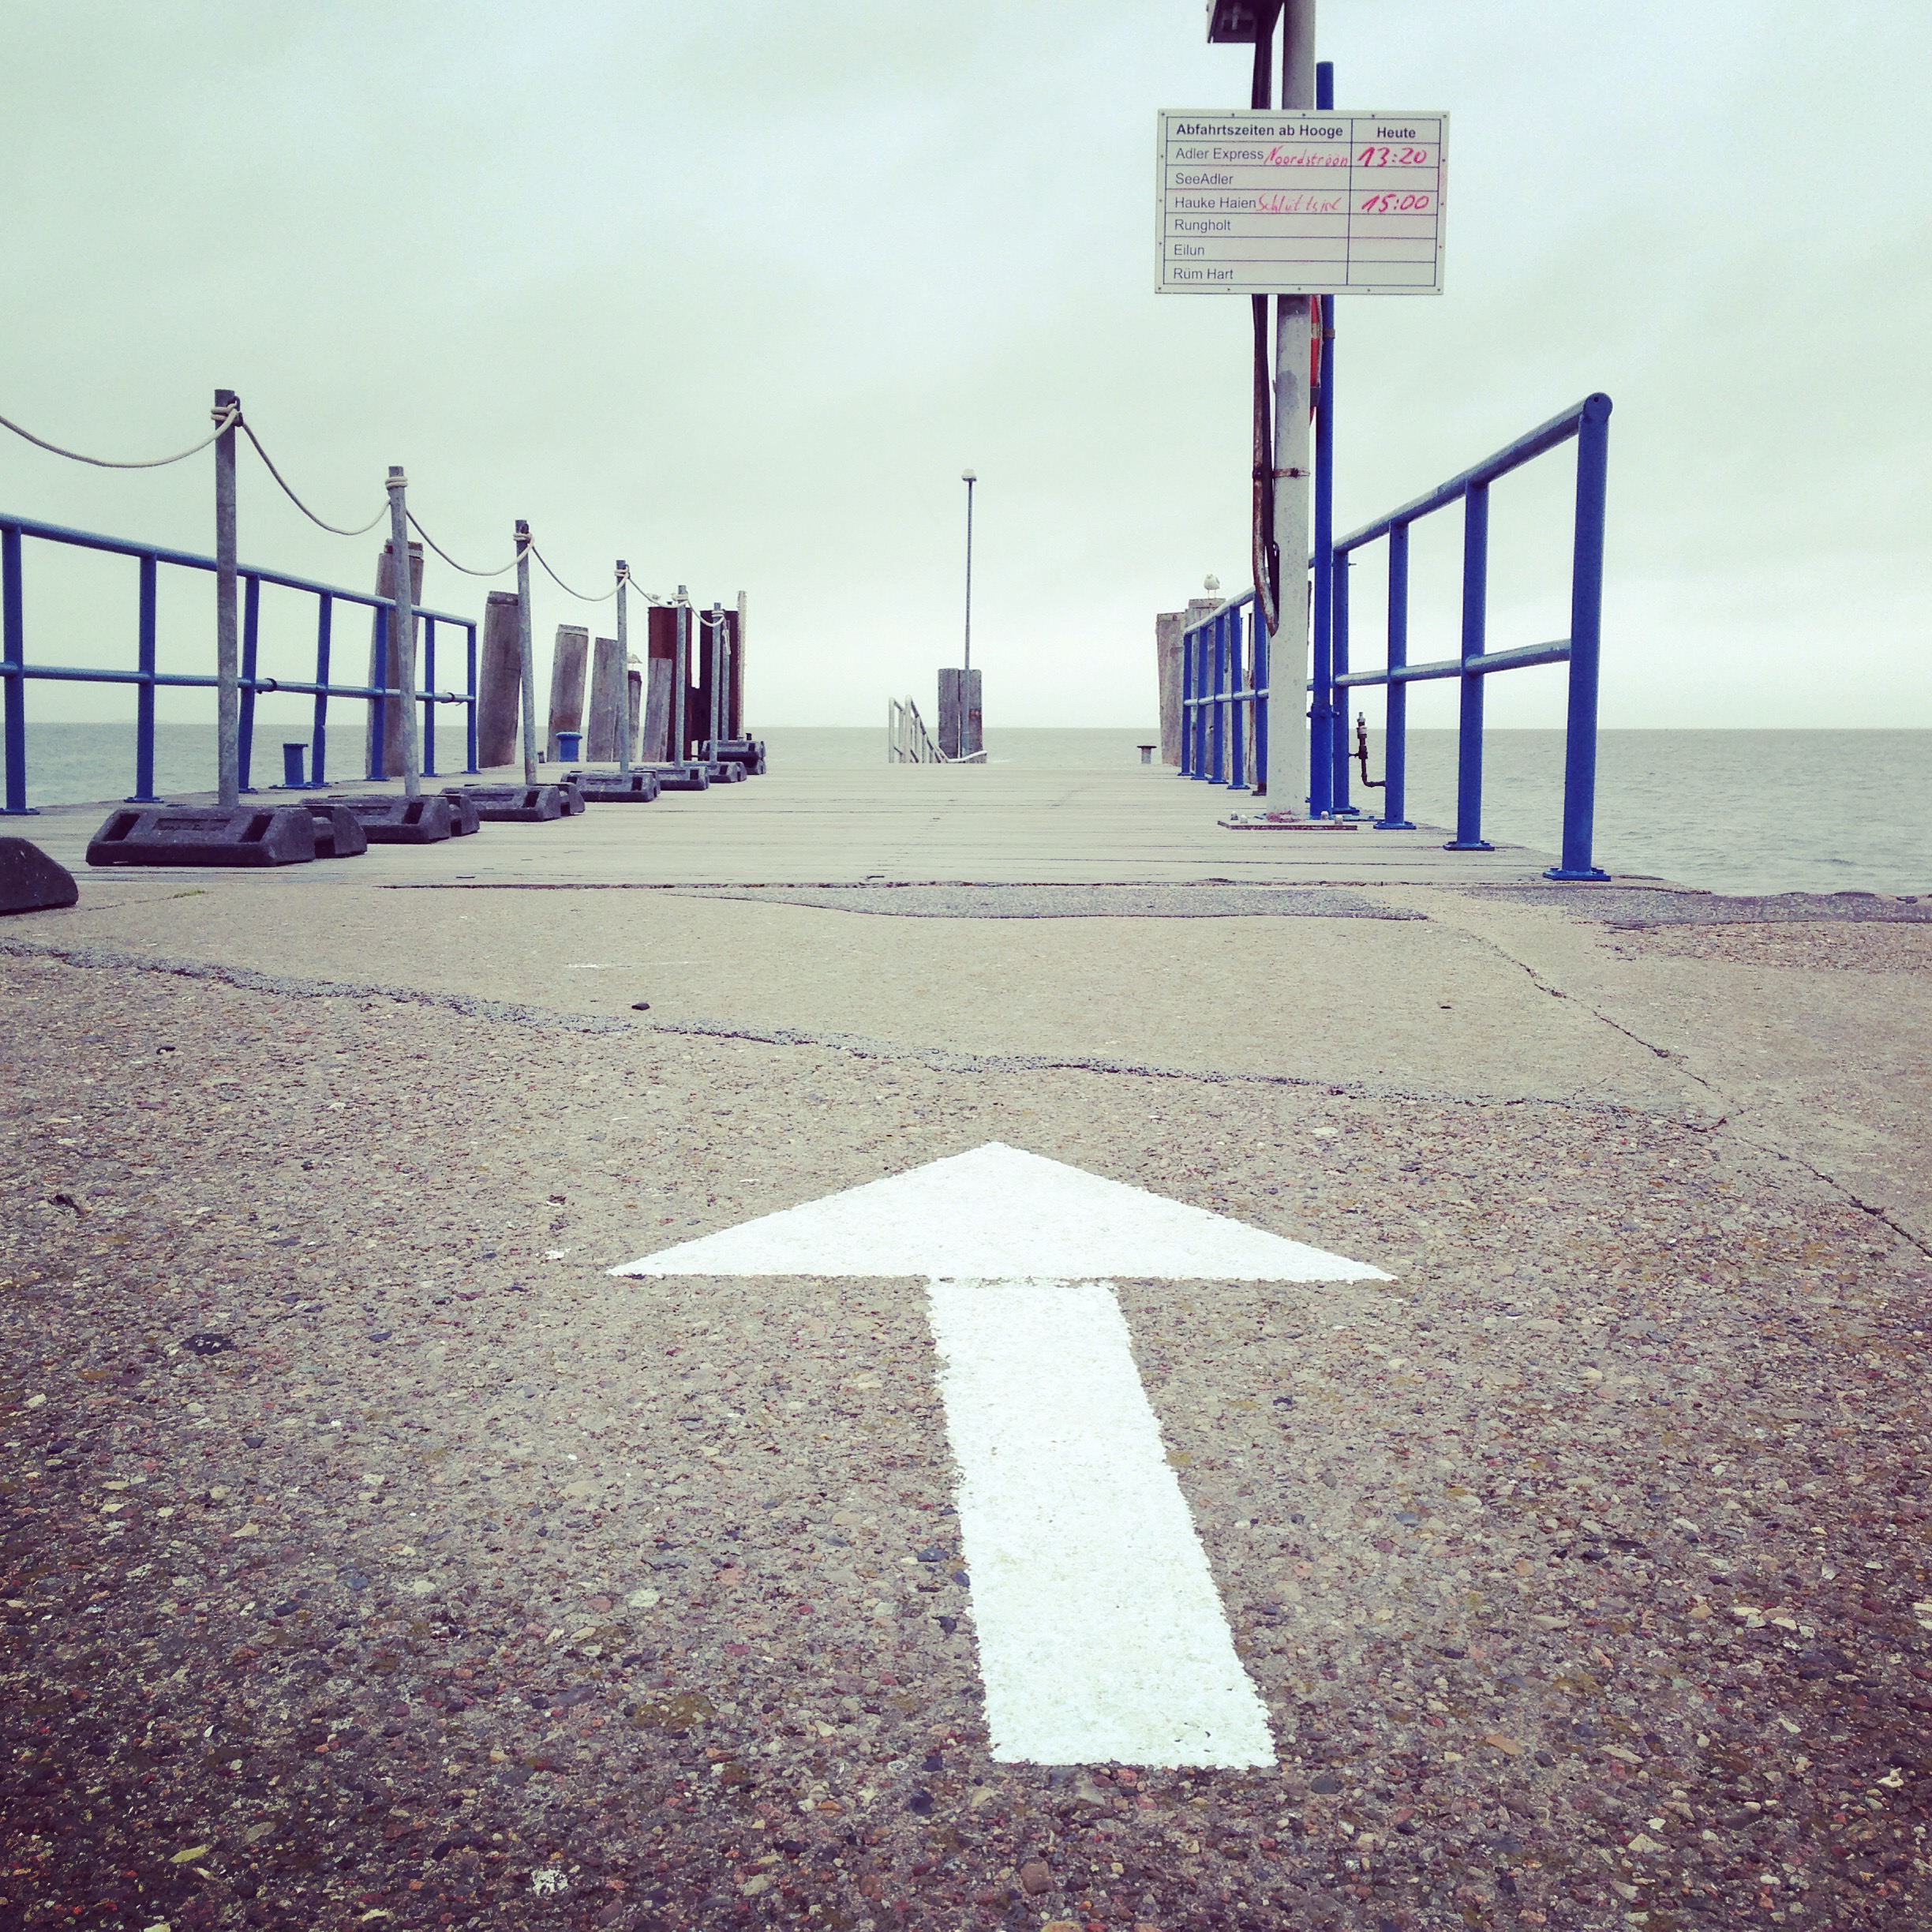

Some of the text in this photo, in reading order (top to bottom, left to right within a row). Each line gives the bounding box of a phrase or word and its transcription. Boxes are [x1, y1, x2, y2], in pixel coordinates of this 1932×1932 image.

[1176, 123, 1343, 139] Abfahrtszeiten ab Hooge
[1376, 126, 1416, 138] Heute
[1175, 148, 1264, 162] Adler Express
[1357, 146, 1428, 167] 13:20
[1175, 172, 1234, 185] SeeAdler
[1174, 197, 1256, 209] Hauke Haien
[1361, 193, 1430, 213] 15:00
[1174, 219, 1231, 234] Rungholt
[1174, 244, 1205, 256] Eilun
[1173, 268, 1234, 279] Rüm Hart
